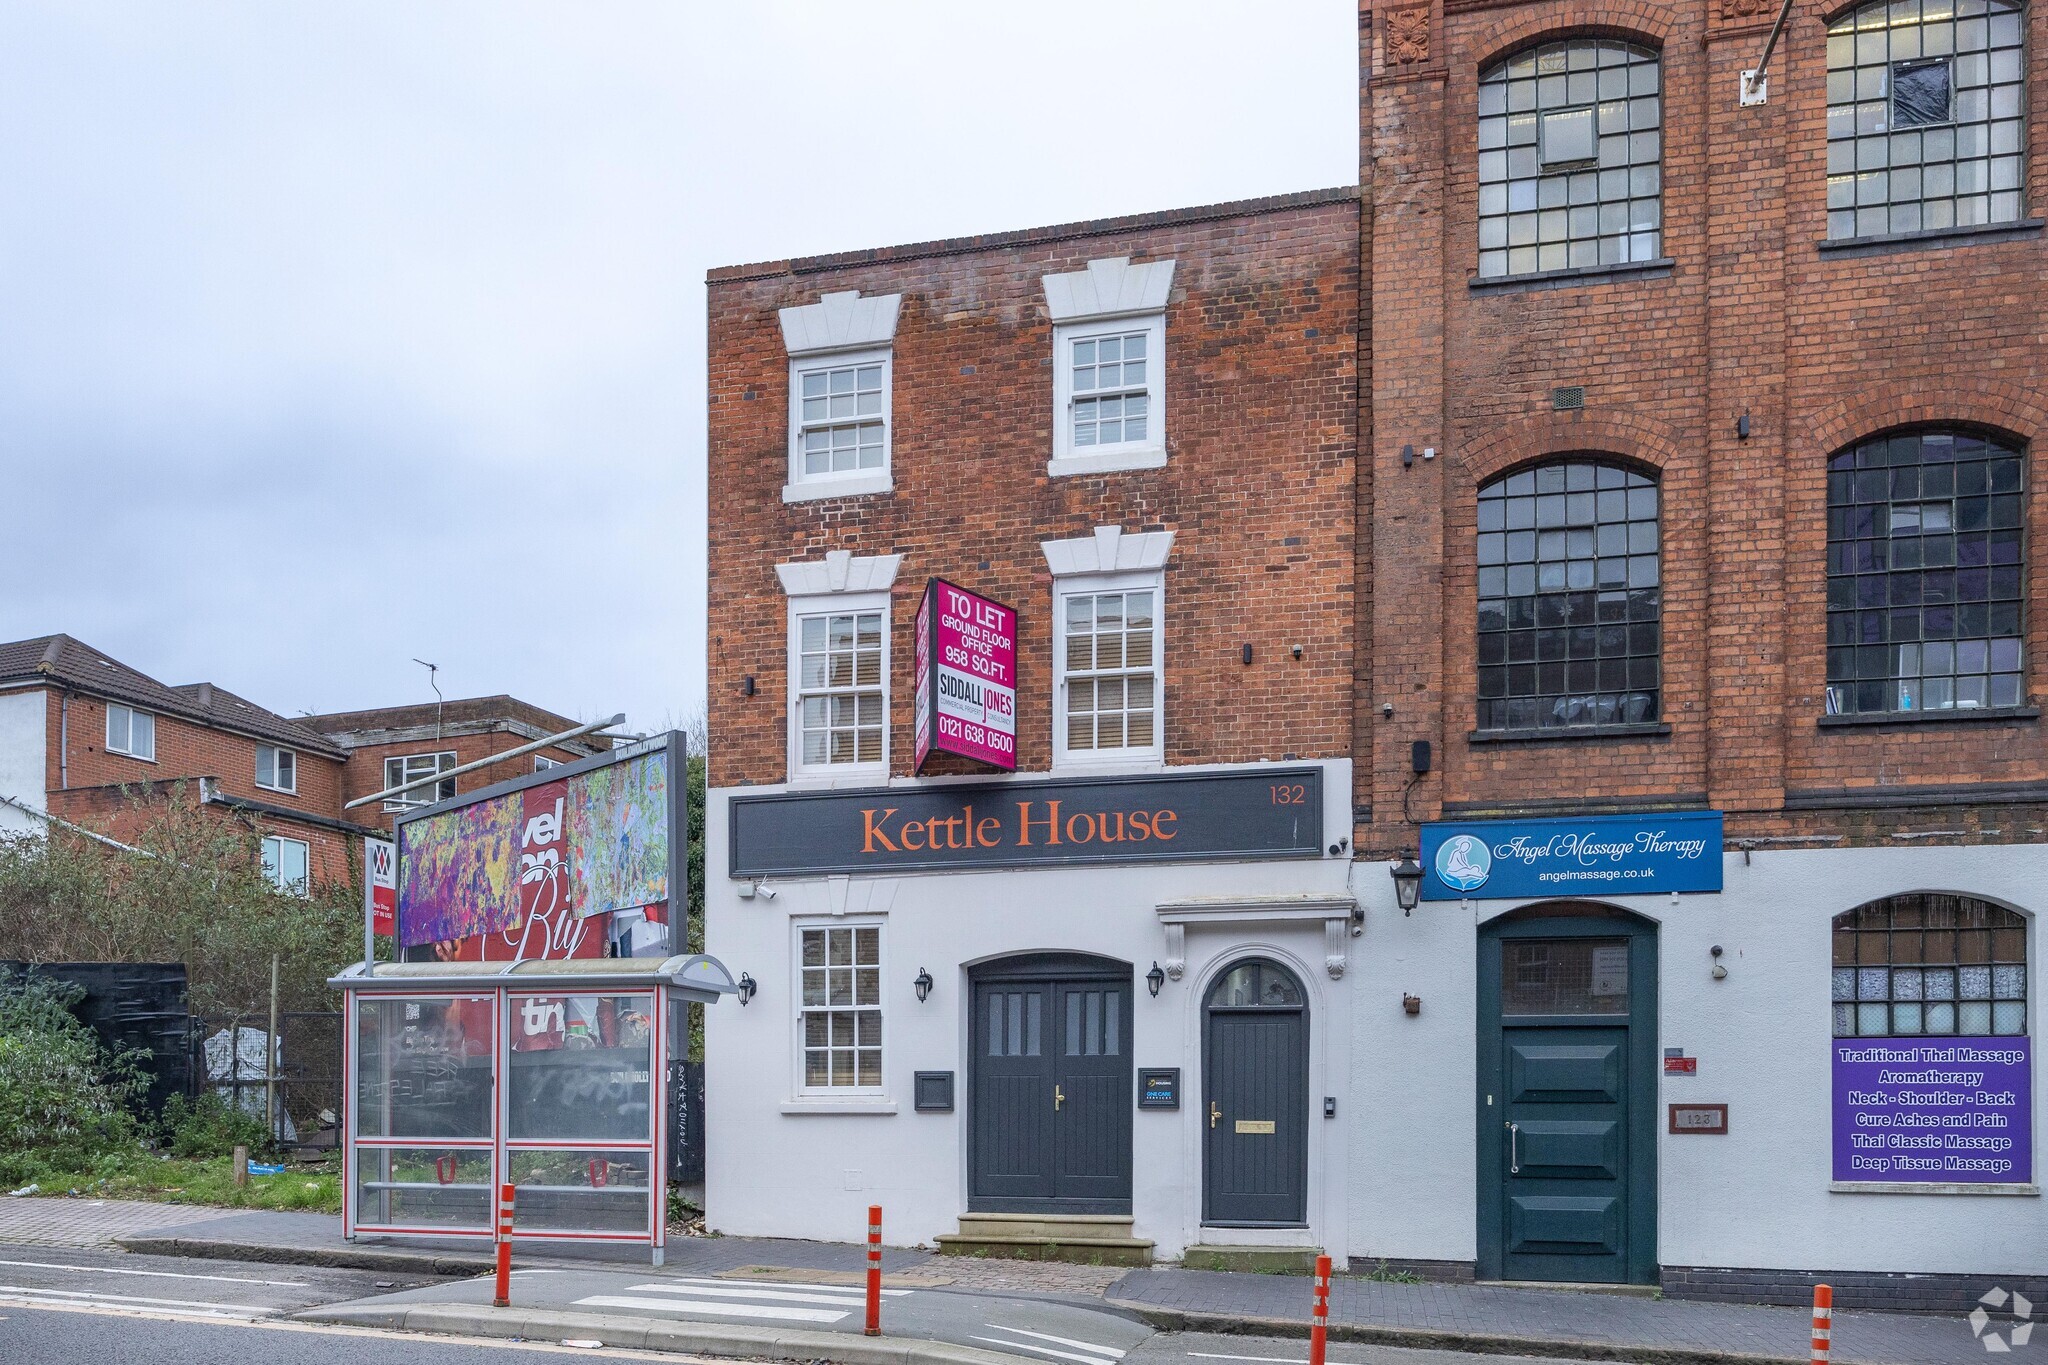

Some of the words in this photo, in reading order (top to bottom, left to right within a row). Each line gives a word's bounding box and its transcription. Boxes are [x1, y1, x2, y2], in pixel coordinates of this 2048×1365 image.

[947, 590, 971, 619] TO
[976, 601, 1006, 632] LET
[941, 614, 980, 639] GROUND
[982, 629, 1011, 651] FLOOR
[961, 635, 993, 657] OFFICE
[945, 645, 968, 667] 958
[972, 654, 1008, 681] SQ.FT.
[940, 673, 983, 707] SIDDALL
[982, 688, 1012, 723] JONES
[940, 697, 965, 711] COMMERCIAL
[964, 704, 983, 716] PROPERTY
[940, 716, 962, 738] 0121
[964, 724, 985, 745] 638
[987, 731, 1013, 753] 0500
[1270, 785, 1306, 805] 132
[859, 805, 1001, 853] Kettle
[1015, 800, 1178, 847] House
[1493, 834, 1561, 865] Angel
[1555, 832, 1634, 866] Massage
[1634, 830, 1706, 860] Therapy
[1539, 867, 1655, 882] angelmassage.co.uk
[1839, 1048, 1917, 1062] Traditional
[1920, 1048, 1954, 1062] Thai
[1957, 1048, 2025, 1065] Massage
[1878, 1069, 1984, 1086] Aromatherapy
[1849, 1091, 1888, 1105] Neck
[1898, 1091, 1964, 1105] Shoulder
[1976, 1091, 2015, 1106] Back
[1687, 1114, 1711, 1125] 123
[1855, 1113, 1891, 1127] Cure
[1893, 1113, 1939, 1127] Aches
[1942, 1113, 1971, 1127] and
[1973, 1113, 2007, 1127] Pain
[1851, 1134, 1884, 1148] Thai
[1887, 1134, 1942, 1148] Classic
[1945, 1134, 2012, 1152] Massage
[1852, 1156, 1889, 1172] Deep
[1892, 1156, 1942, 1170] Tissue
[1945, 1156, 2012, 1172] Massage
